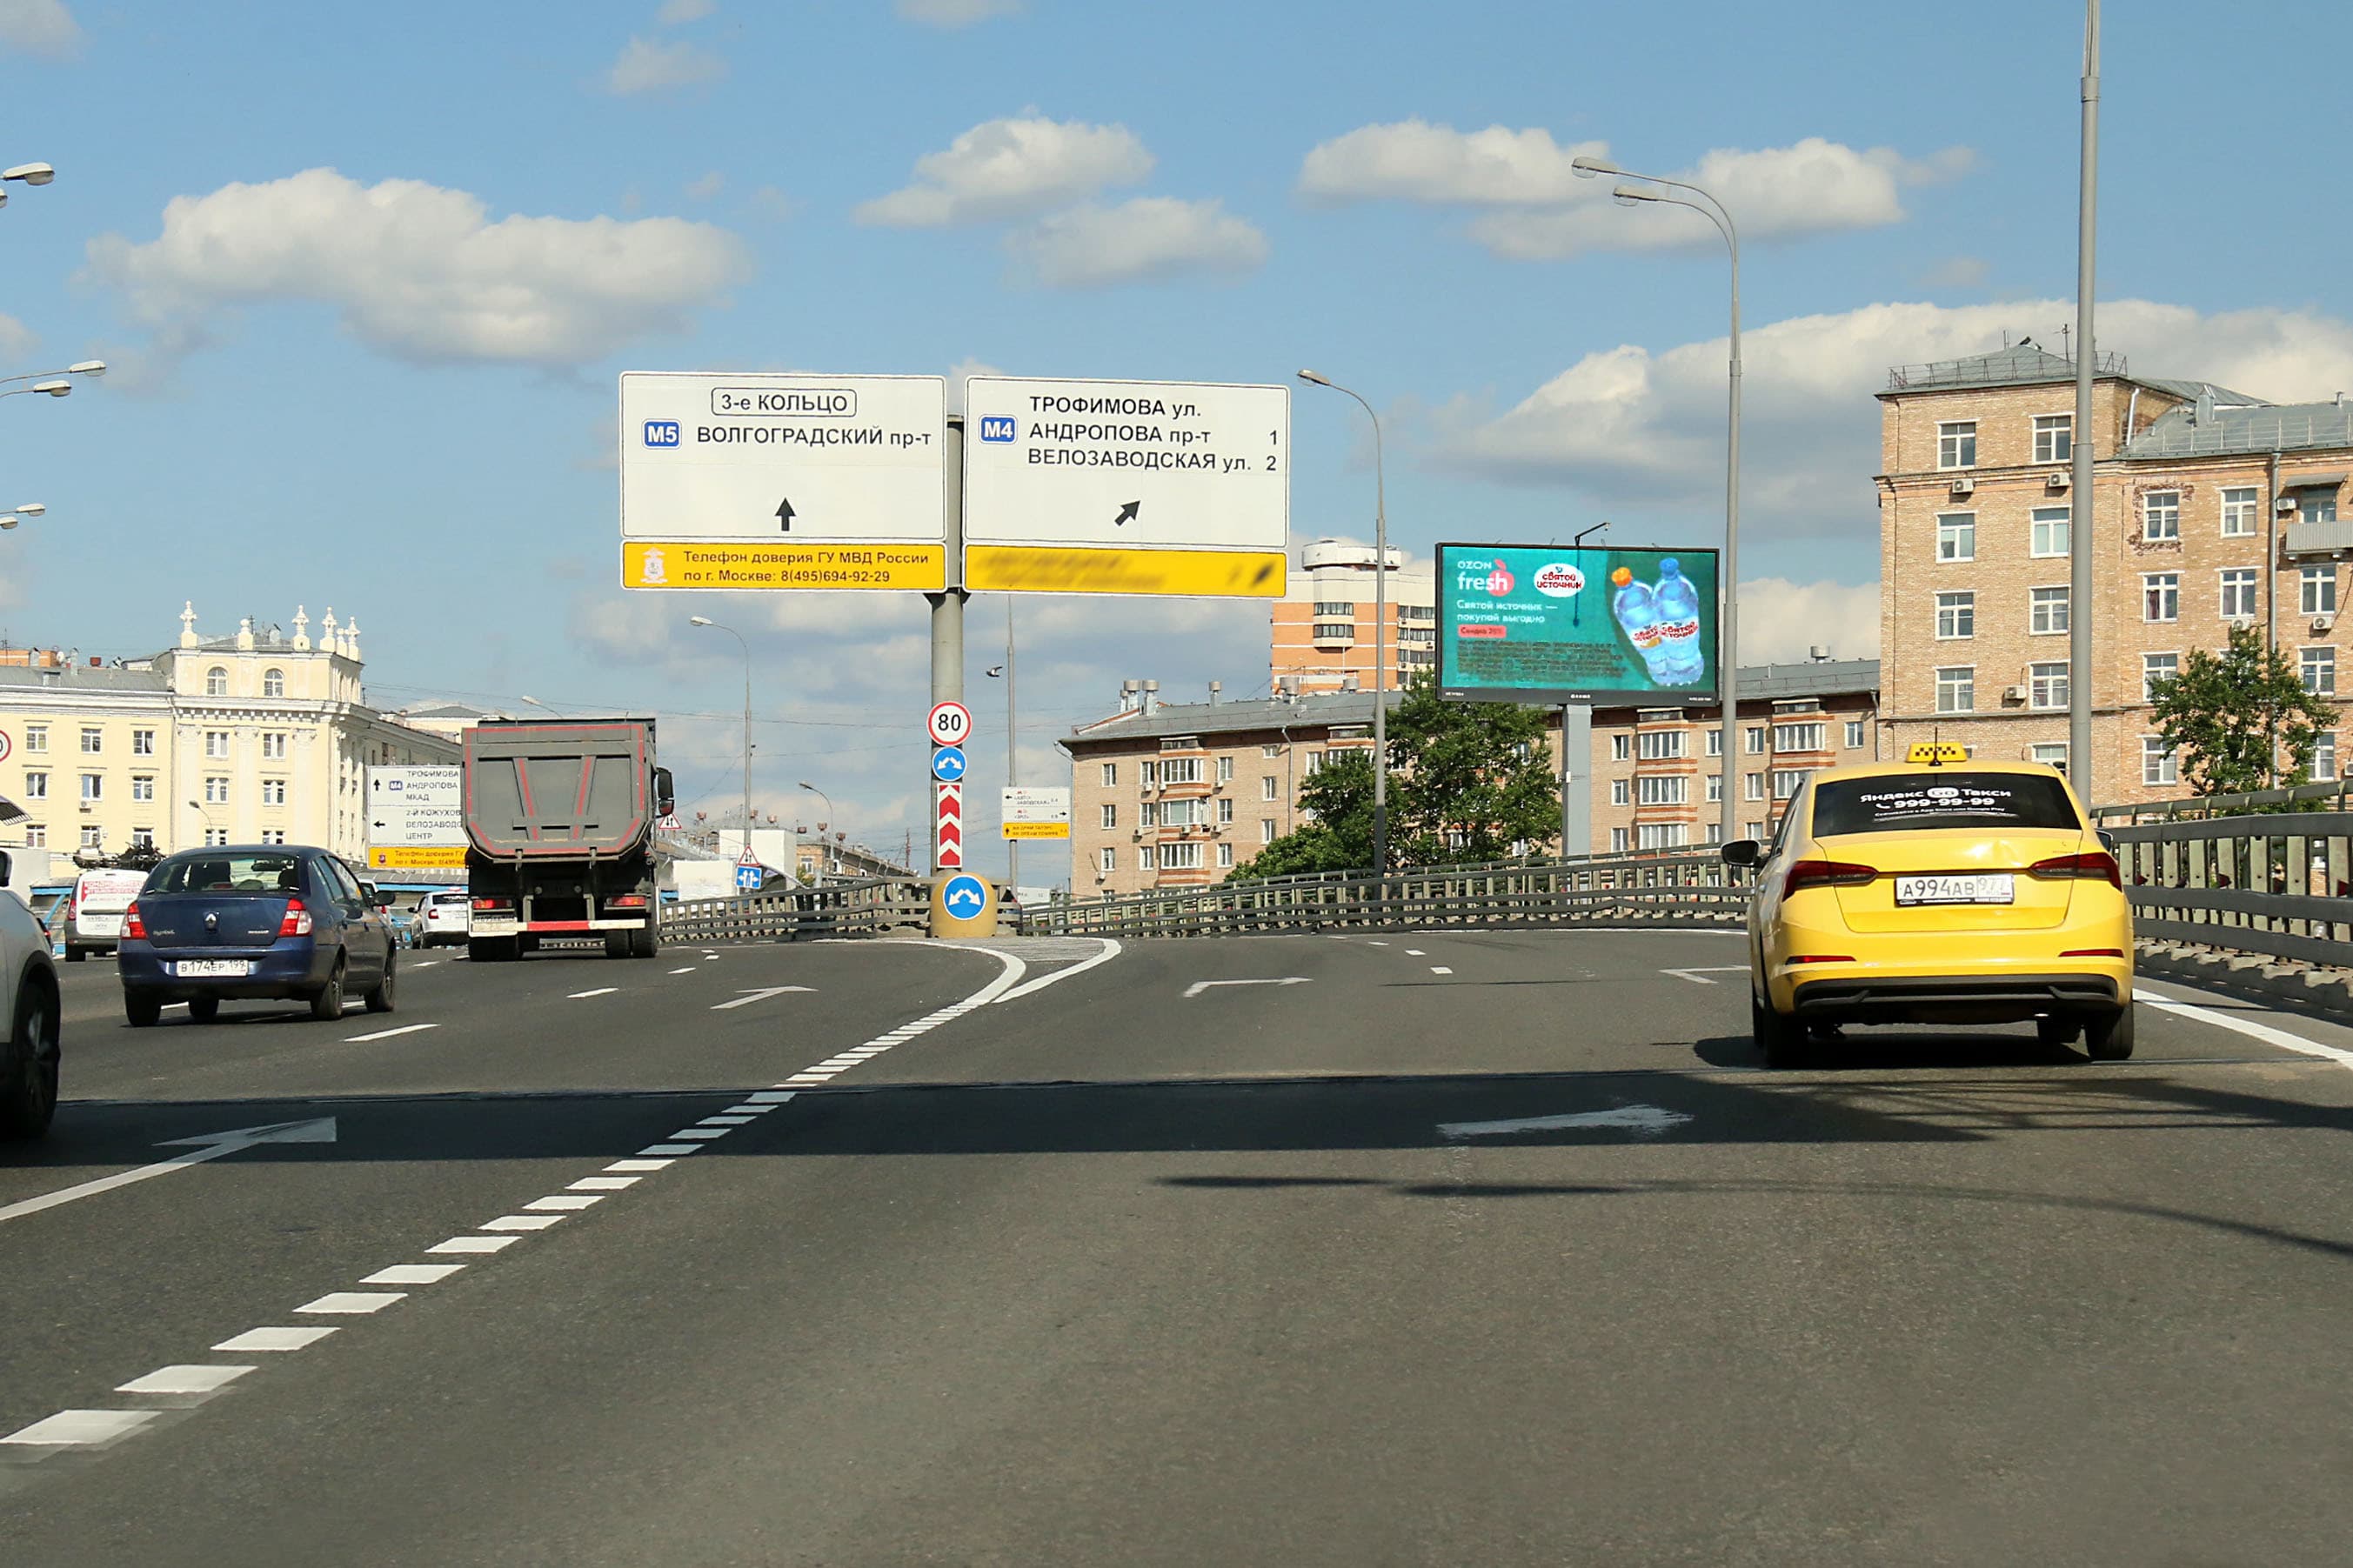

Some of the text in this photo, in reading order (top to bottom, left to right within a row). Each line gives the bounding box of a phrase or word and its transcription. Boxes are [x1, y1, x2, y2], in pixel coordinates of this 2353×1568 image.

[721, 394, 848, 414] 3-е КОЛЬЦО
[1029, 397, 1202, 419] ТРОФИМОВА ул.
[697, 425, 932, 449] ВОЛГОГРАДСКИЙ пр-т
[1029, 423, 1278, 446] АНДРОПОВА пр-т 1
[1028, 449, 1277, 473] ВЕЛОЗАВОДСКАЯ ул. 2
[684, 550, 929, 566] Телефон доверия ГУ МВД России
[684, 570, 891, 584] по г. Москве: 8(495)694-92-29
[1457, 571, 1508, 591] fresh
[1456, 599, 1494, 610] Святой
[938, 713, 962, 731] 80
[1860, 791, 1925, 803] Яндекс
[1960, 788, 2012, 797] Такси
[1893, 797, 1996, 810] 999-99-99
[405, 832, 433, 841] ЦЕНТР
[1903, 877, 2006, 897] А994АВ 977
[180, 959, 225, 973] В174ЕР
